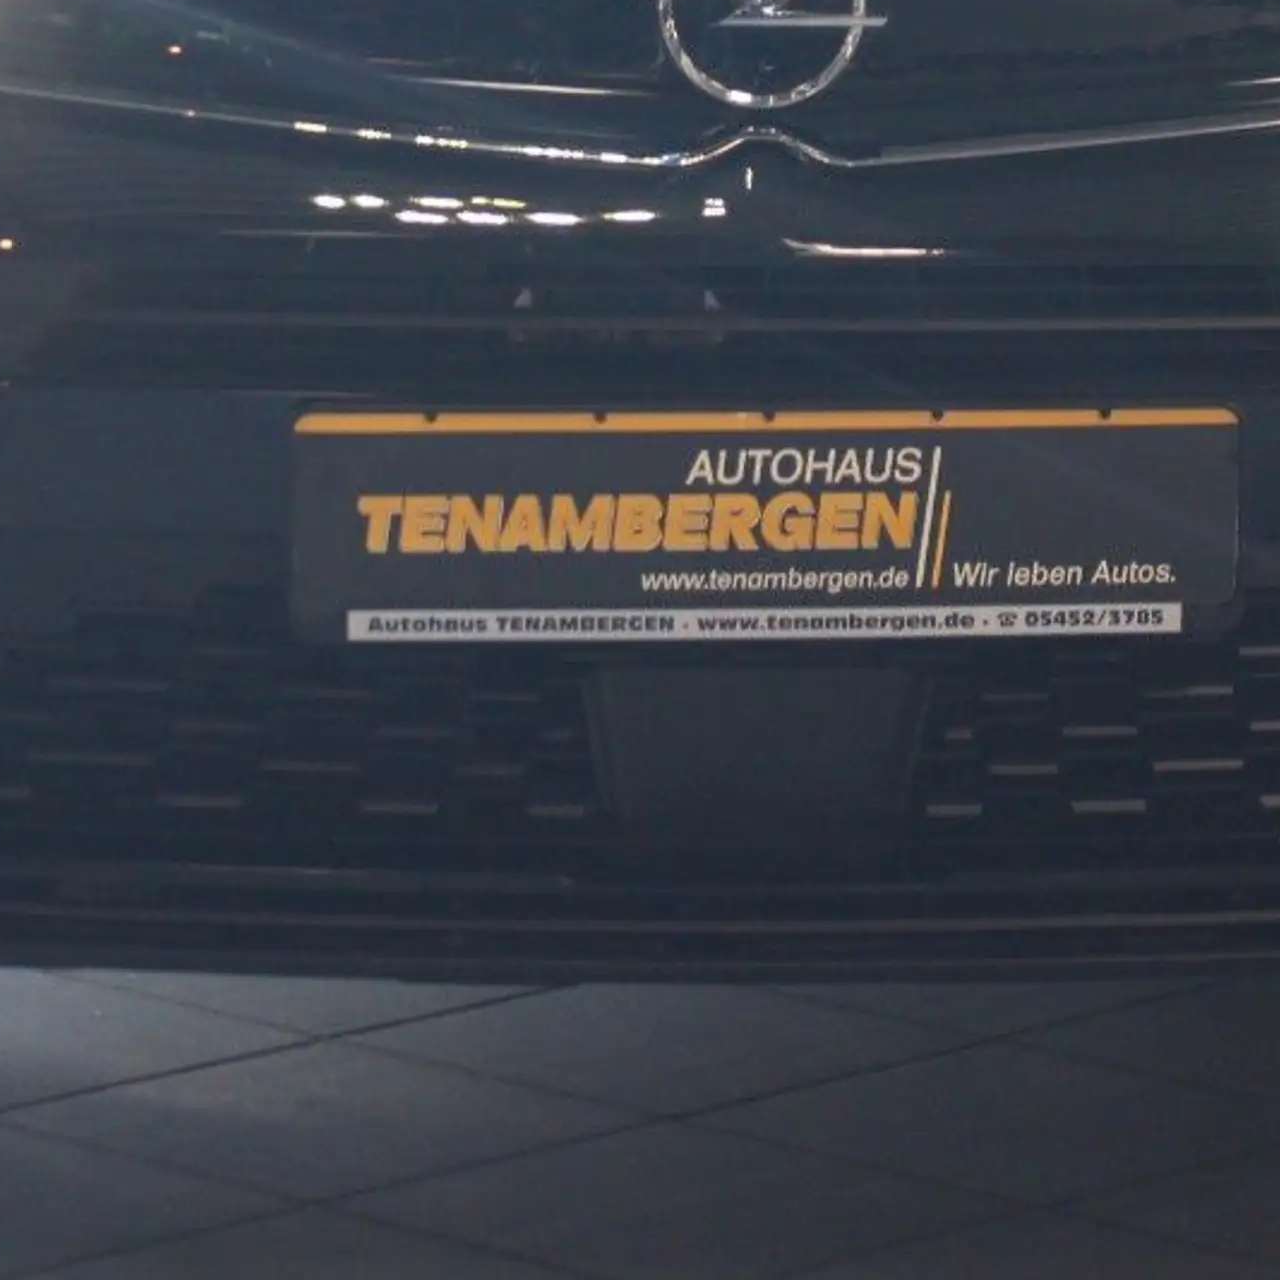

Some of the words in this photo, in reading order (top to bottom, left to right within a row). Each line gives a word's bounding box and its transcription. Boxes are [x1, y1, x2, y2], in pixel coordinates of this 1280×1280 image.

[685, 447, 923, 486] AUTOHAUS
[357, 491, 920, 553] TENAMBERGEN
[640, 566, 910, 593] www.tenambergen.de
[952, 562, 999, 588] Wir
[1006, 562, 1083, 587] leben
[1090, 559, 1177, 584] Autos.
[368, 616, 488, 634] Autohaus
[496, 615, 676, 633] TENAMBERGEN
[697, 610, 976, 633] www.tenambergen.de
